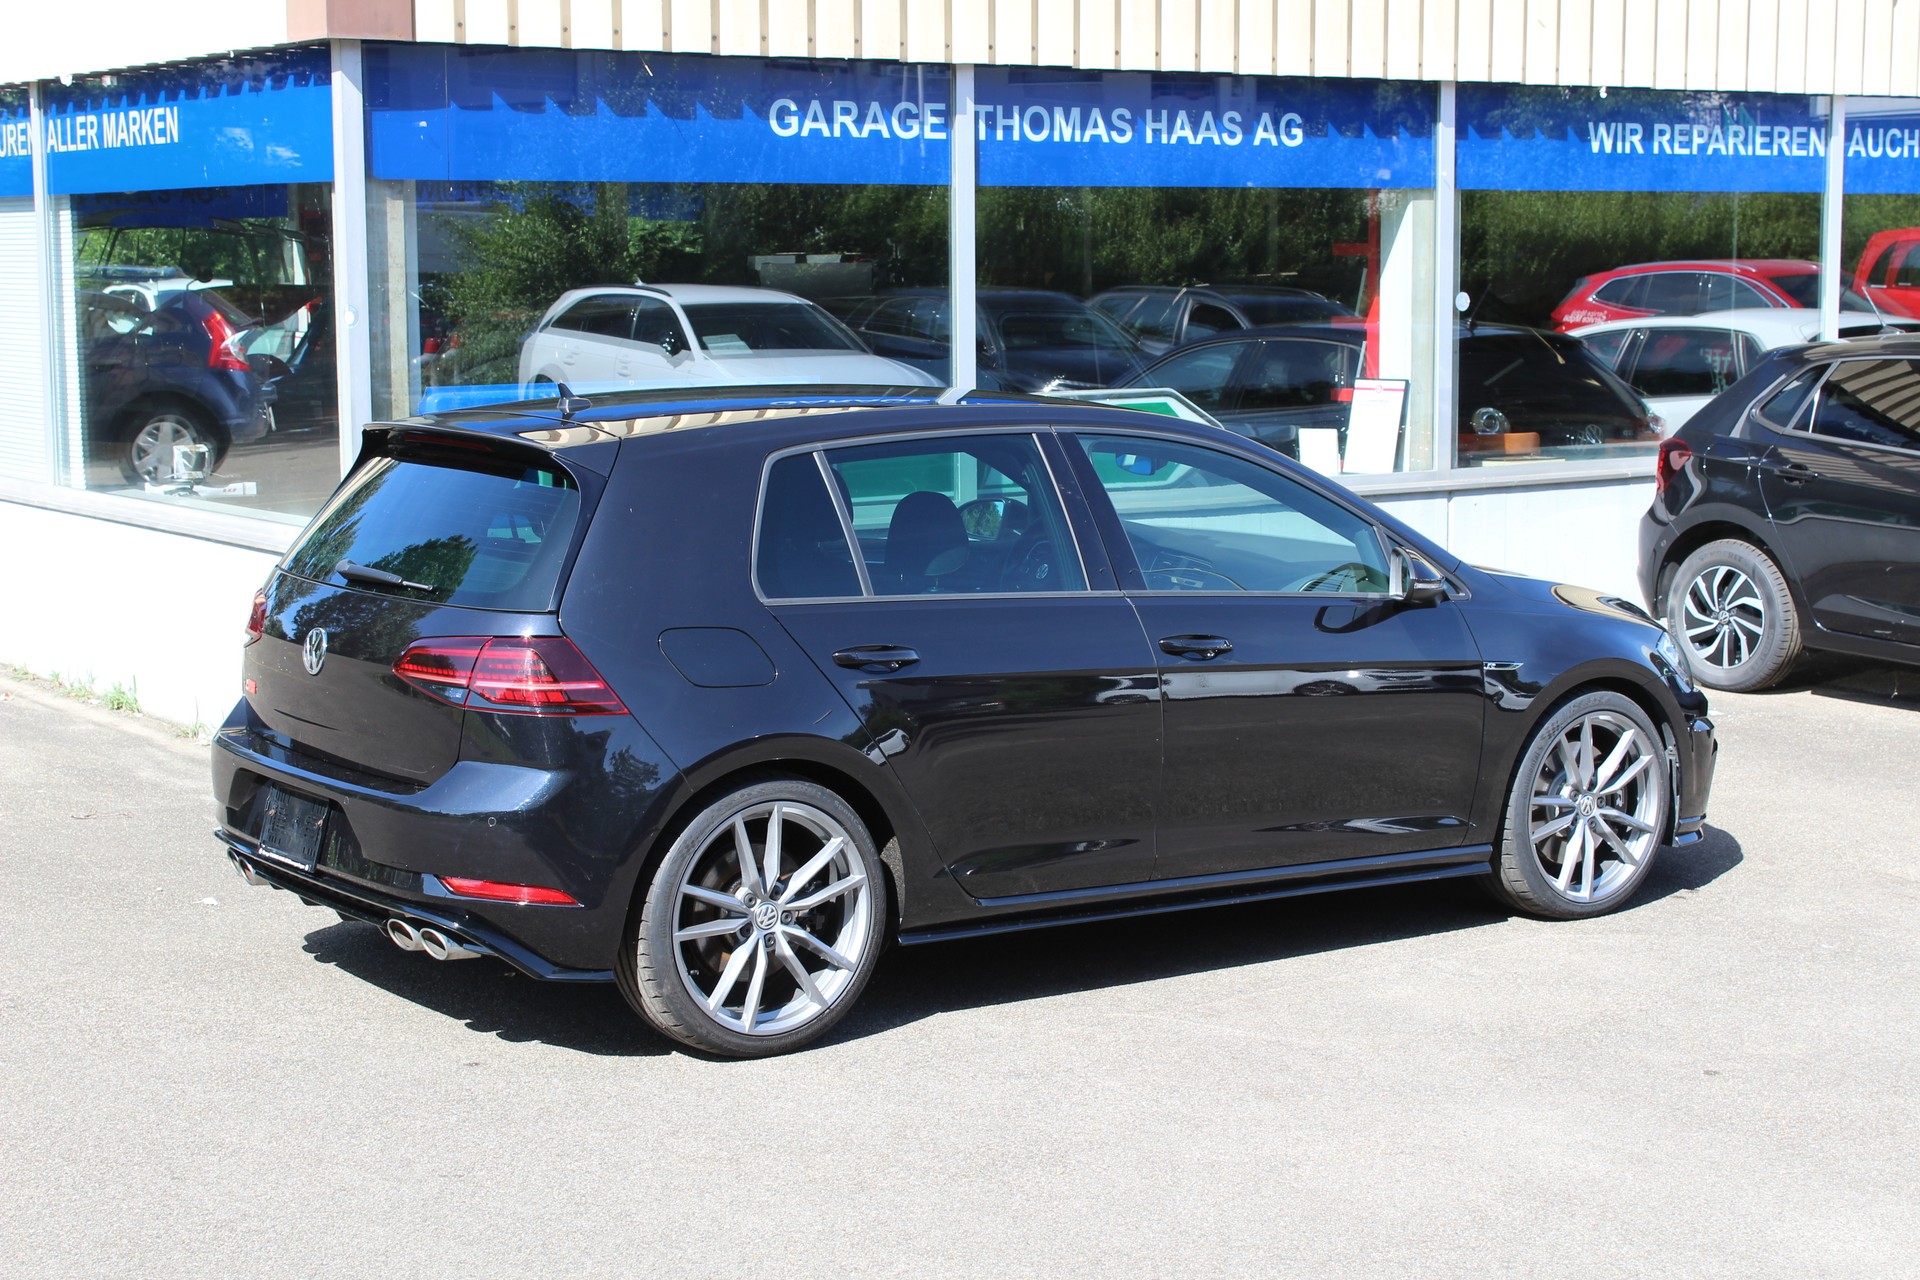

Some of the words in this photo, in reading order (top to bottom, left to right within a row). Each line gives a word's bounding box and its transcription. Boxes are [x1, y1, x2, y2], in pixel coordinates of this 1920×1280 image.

[47, 115, 99, 153] ALLER
[102, 106, 178, 148] MARKEN
[769, 98, 946, 139] GARAGE
[973, 105, 1132, 143] THOMAS
[1146, 109, 1242, 145] HAAS
[1253, 112, 1304, 147] AG
[1589, 122, 1644, 154] WIR
[1653, 124, 1826, 157] REPARIEREN
[1847, 127, 1920, 158] AUCH
